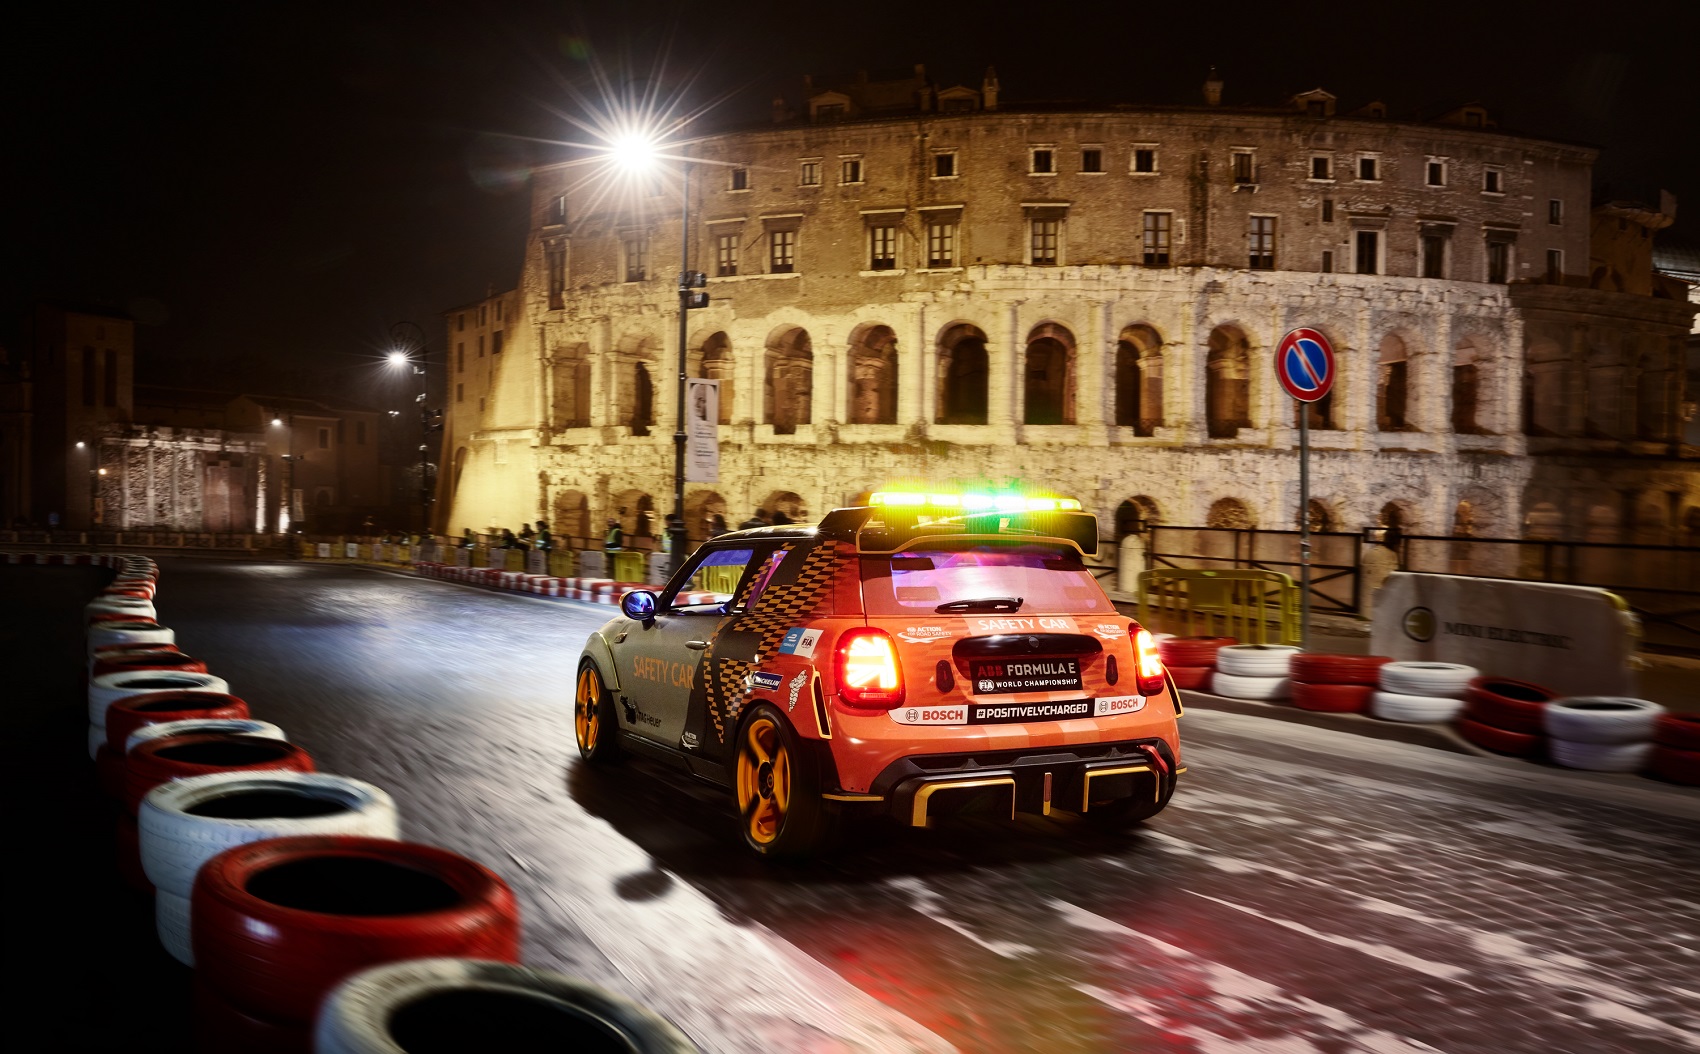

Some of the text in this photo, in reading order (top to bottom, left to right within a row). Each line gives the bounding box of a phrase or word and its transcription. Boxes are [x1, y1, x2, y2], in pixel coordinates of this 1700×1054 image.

[977, 618, 1070, 631] SAFETY CAR
[1443, 621, 1483, 639] MINI
[801, 637, 813, 647] FIA
[633, 655, 695, 690] SAFETY CAR
[977, 662, 1076, 677] ABB FORMULA E
[979, 678, 1078, 691] FIA WORLD CHAMPIONSHIP
[976, 703, 1088, 719] #POSITIVELYCHARGED
[1110, 698, 1138, 711] BOSCH
[922, 710, 964, 720] BOSCH
